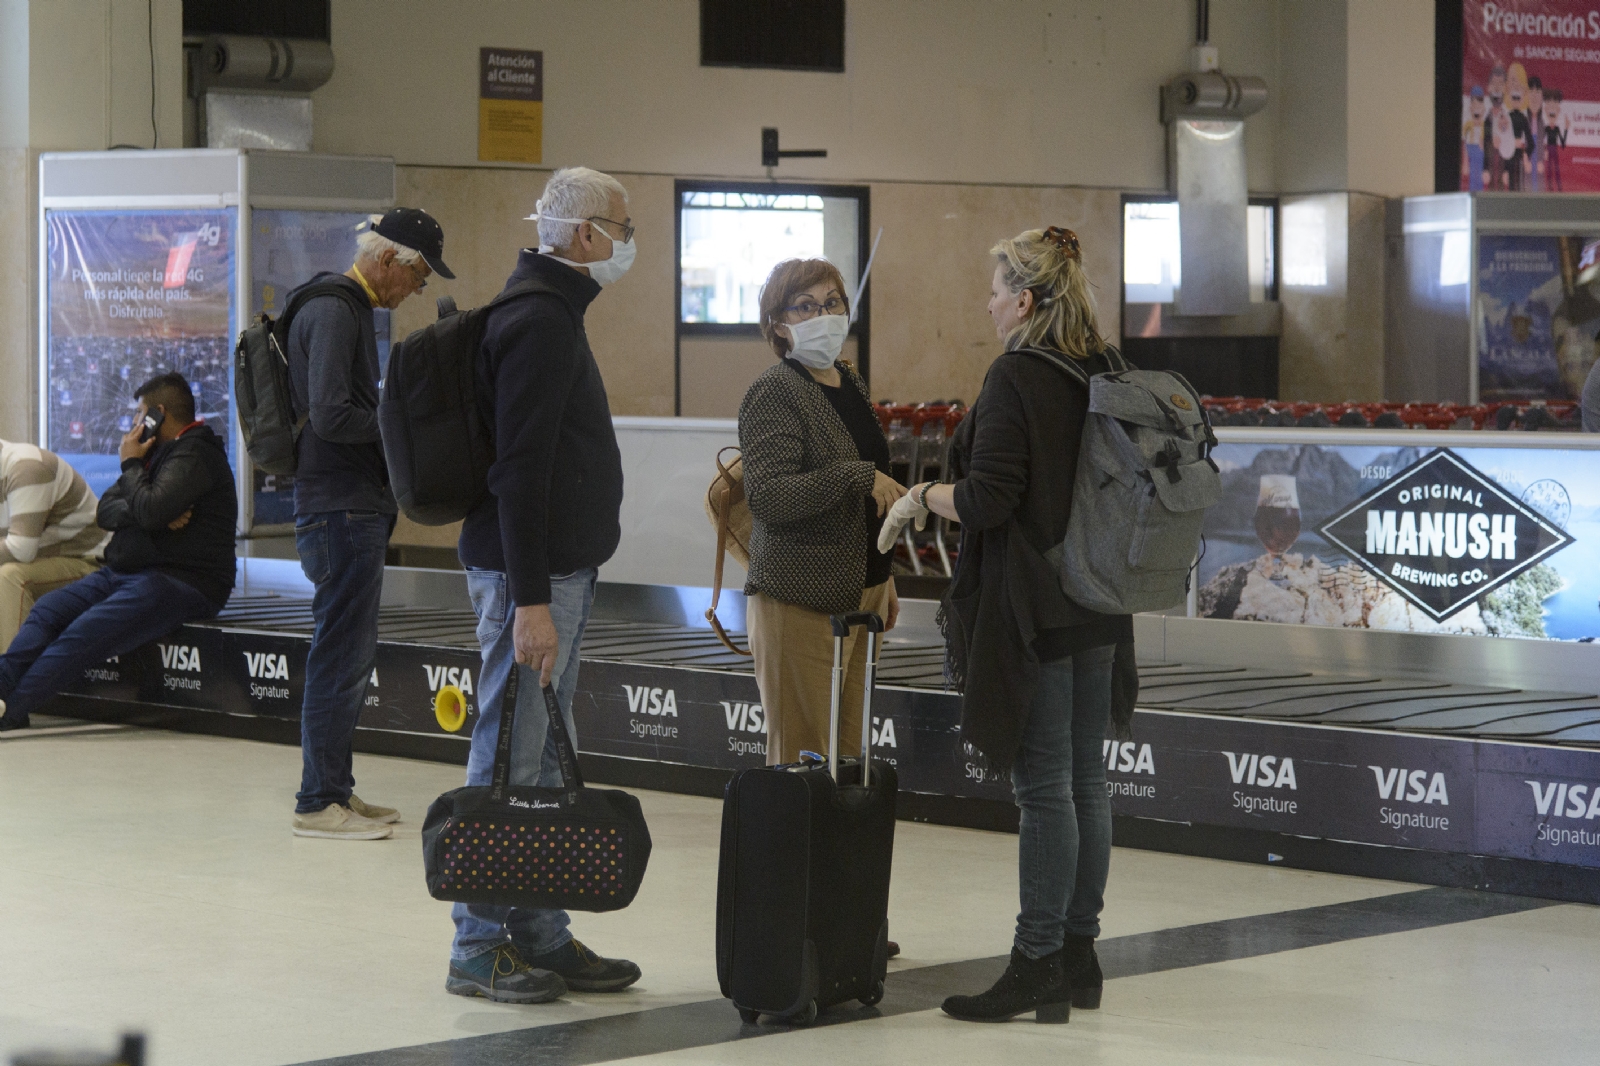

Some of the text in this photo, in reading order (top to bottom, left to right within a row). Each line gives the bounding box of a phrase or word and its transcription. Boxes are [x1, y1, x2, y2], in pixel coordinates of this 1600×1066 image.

[1483, 2, 1585, 39] Prevención
[487, 53, 536, 69] Atención
[487, 68, 536, 85] al Cliente
[198, 222, 221, 246] 4g
[72, 268, 204, 283] Personal tiene la red 4G
[84, 286, 106, 300] más
[107, 286, 145, 303] rápida
[146, 286, 164, 300] del
[109, 304, 163, 319] Disfrutala
[1360, 465, 1392, 480] DESDE
[1398, 483, 1484, 508] ORIGINAL
[1365, 509, 1517, 560] MANUSH
[1391, 562, 1489, 588] BREWING CO.
[156, 643, 202, 673] VISA
[243, 651, 290, 681] VISA
[163, 674, 202, 691] Signature
[250, 682, 290, 700] Signature
[421, 664, 474, 696] VISA
[621, 684, 679, 718] VISA
[629, 719, 679, 739] Signature
[727, 736, 768, 757] Signatu
[1221, 751, 1298, 790] VISA
[1105, 781, 1156, 799] gnature
[1367, 765, 1450, 806] VISA
[1232, 791, 1298, 814] Signature
[1379, 807, 1450, 831] Signature
